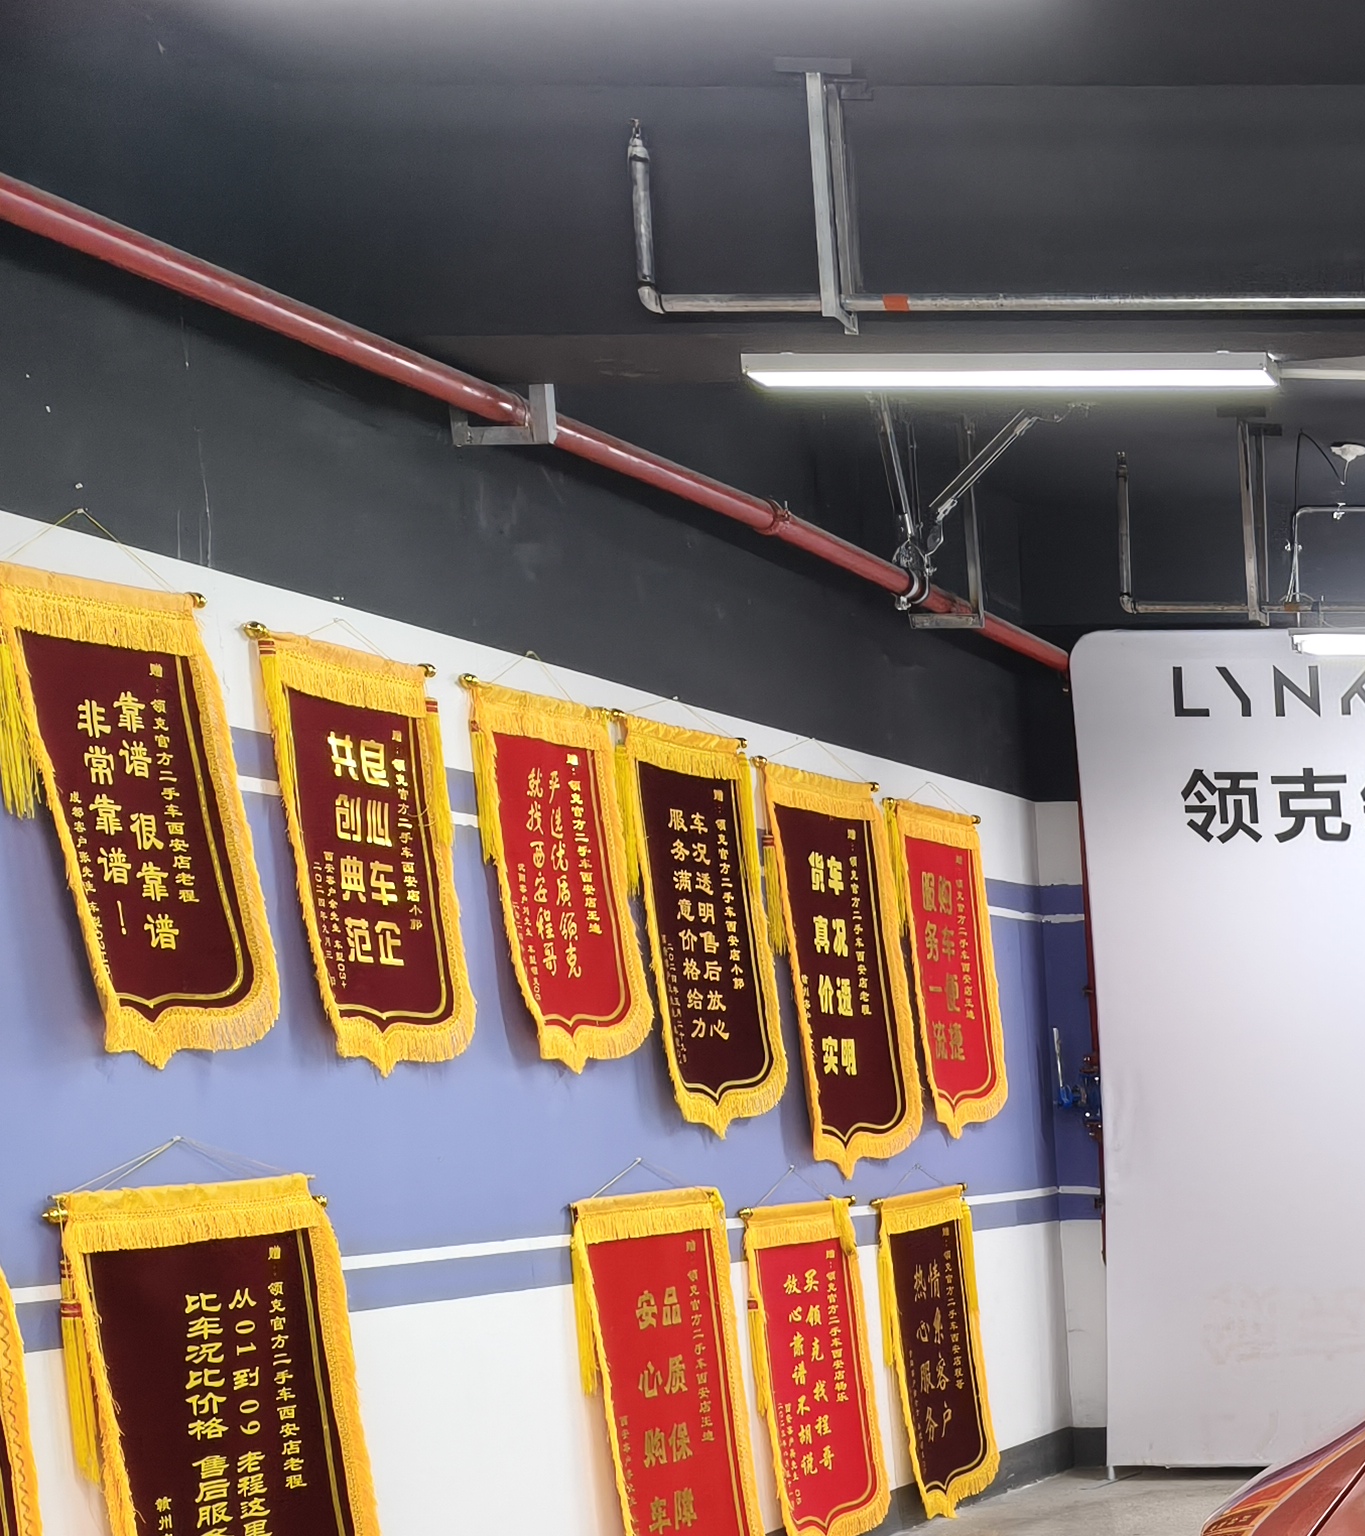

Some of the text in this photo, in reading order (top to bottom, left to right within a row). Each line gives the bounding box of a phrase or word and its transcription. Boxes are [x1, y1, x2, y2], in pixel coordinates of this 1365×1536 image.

[327, 730, 375, 965] 共创典范
[525, 766, 558, 977] 就找西安程哥
[668, 807, 707, 1040] 服务满意价格给力
[689, 811, 730, 1041] 车况透明售后放心
[808, 850, 839, 1076] 货真价实
[827, 855, 858, 1077] 车况透明
[183, 1292, 231, 1441] 比车况比价格
[635, 1289, 672, 1536] 安心购车
[662, 1285, 698, 1531] 品质保障
[913, 1262, 938, 1443] 热心服务
